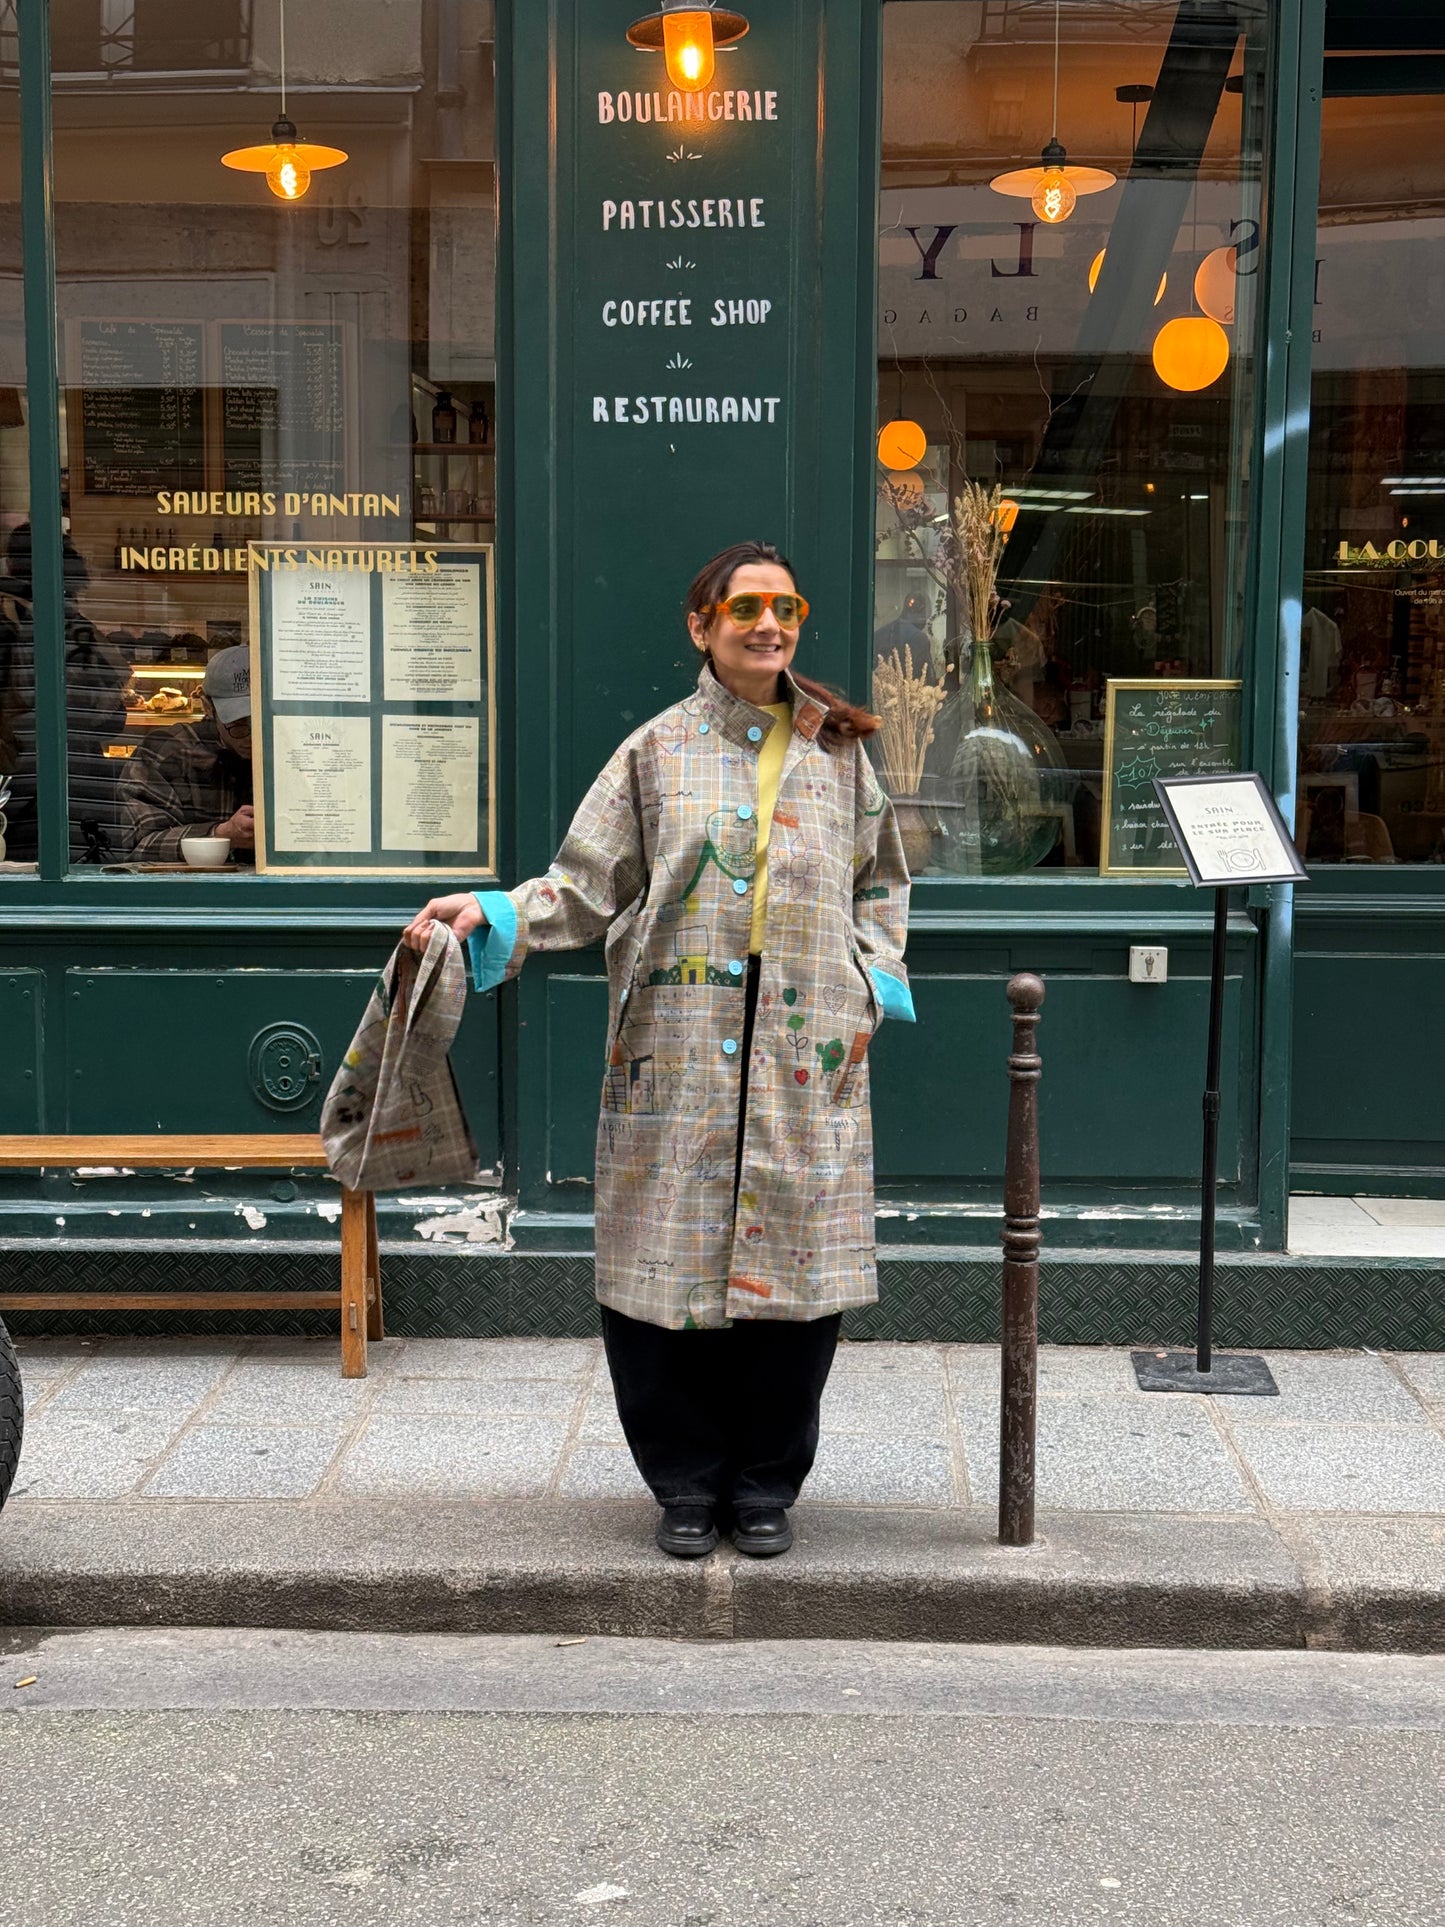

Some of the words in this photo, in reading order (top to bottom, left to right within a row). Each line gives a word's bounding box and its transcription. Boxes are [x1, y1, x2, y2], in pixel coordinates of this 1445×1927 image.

[598, 90, 778, 124] BOULANGERIE
[602, 198, 766, 231] PATISSERIE
[602, 300, 692, 327] COFFEE
[710, 299, 772, 327] SHOP
[592, 396, 781, 424] RESTAURANT
[157, 491, 276, 516] SAVEURS
[285, 493, 400, 517] D'ANTAN
[120, 543, 298, 572] INGRÉDIENTS
[306, 549, 438, 573] NATURELS
[1340, 541, 1379, 560] LA
[309, 582, 332, 590] SAIN
[309, 732, 332, 740] SAIN
[1205, 807, 1234, 815] SAIN
